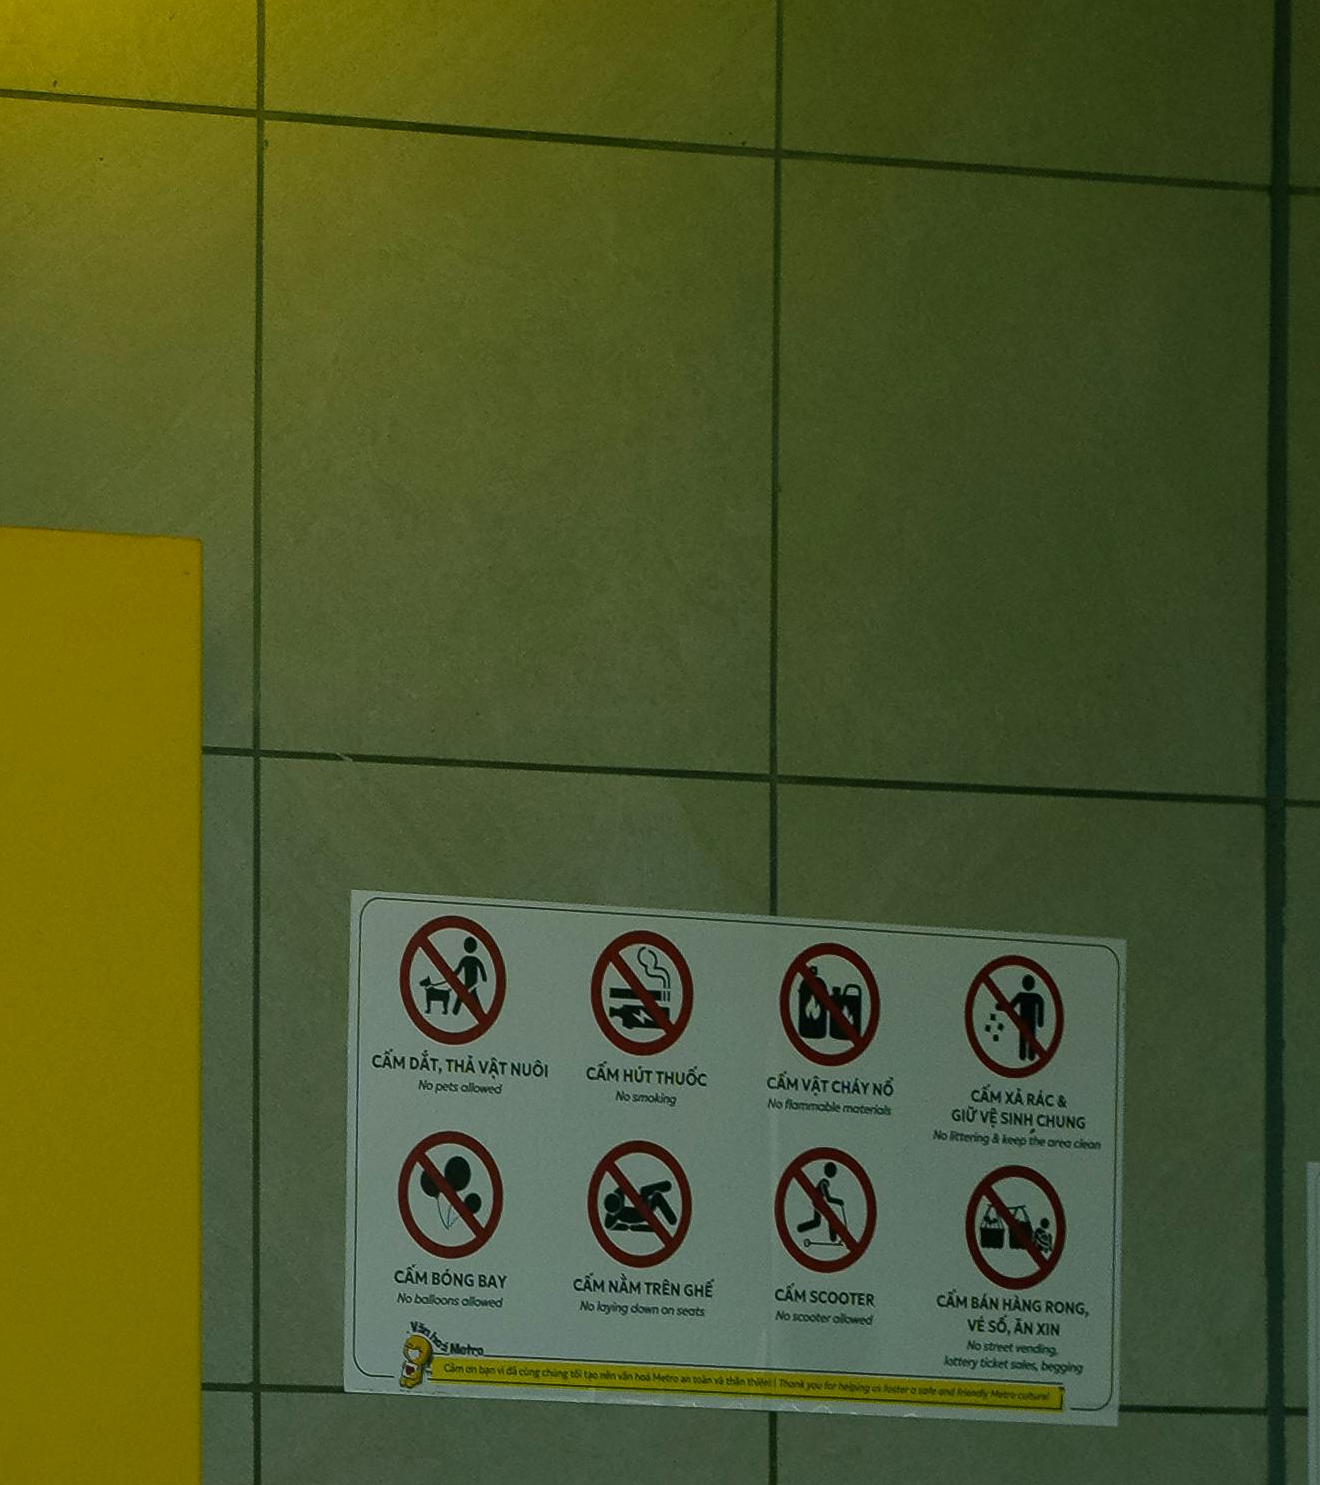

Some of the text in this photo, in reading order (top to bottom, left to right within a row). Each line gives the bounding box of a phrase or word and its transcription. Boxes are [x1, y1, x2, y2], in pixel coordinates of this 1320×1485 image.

[372, 1049, 549, 1078] CẤM DẮT, THẢ VẬT NUÔI
[586, 1061, 707, 1086] CẤM HÚT THUỐC
[418, 1080, 502, 1094] No pets allowed
[767, 1071, 799, 1090] CẤM
[802, 1075, 829, 1096] VẬT
[831, 1078, 869, 1094] CHÁY
[615, 1090, 677, 1107] No smoking
[768, 1098, 783, 1109] No
[971, 1084, 1067, 1107] CẤM XẢ RÁC &
[951, 1106, 1086, 1129] GIỮ VỆ SINH CHUNG
[933, 1130, 948, 1141] No
[950, 1130, 990, 1146] littering
[1002, 1134, 1027, 1147] keep
[1074, 1139, 1101, 1149] clean
[394, 1264, 507, 1289] CẤM BÓNG BAY
[573, 1272, 715, 1297] CẤM NẰM TRÊN GHẾ
[397, 1293, 503, 1307] No balloons allowed
[775, 1282, 875, 1307] CẤM SCOOTER
[936, 1289, 1090, 1318] CẤM BÁN HÀNG RONG,
[580, 1301, 705, 1316] No laying down on seats
[775, 1311, 790, 1321] No
[967, 1314, 1060, 1336] VÉ SỐ, ĂN XIN
[450, 1343, 484, 1356] Metro
[967, 1340, 981, 1351] No
